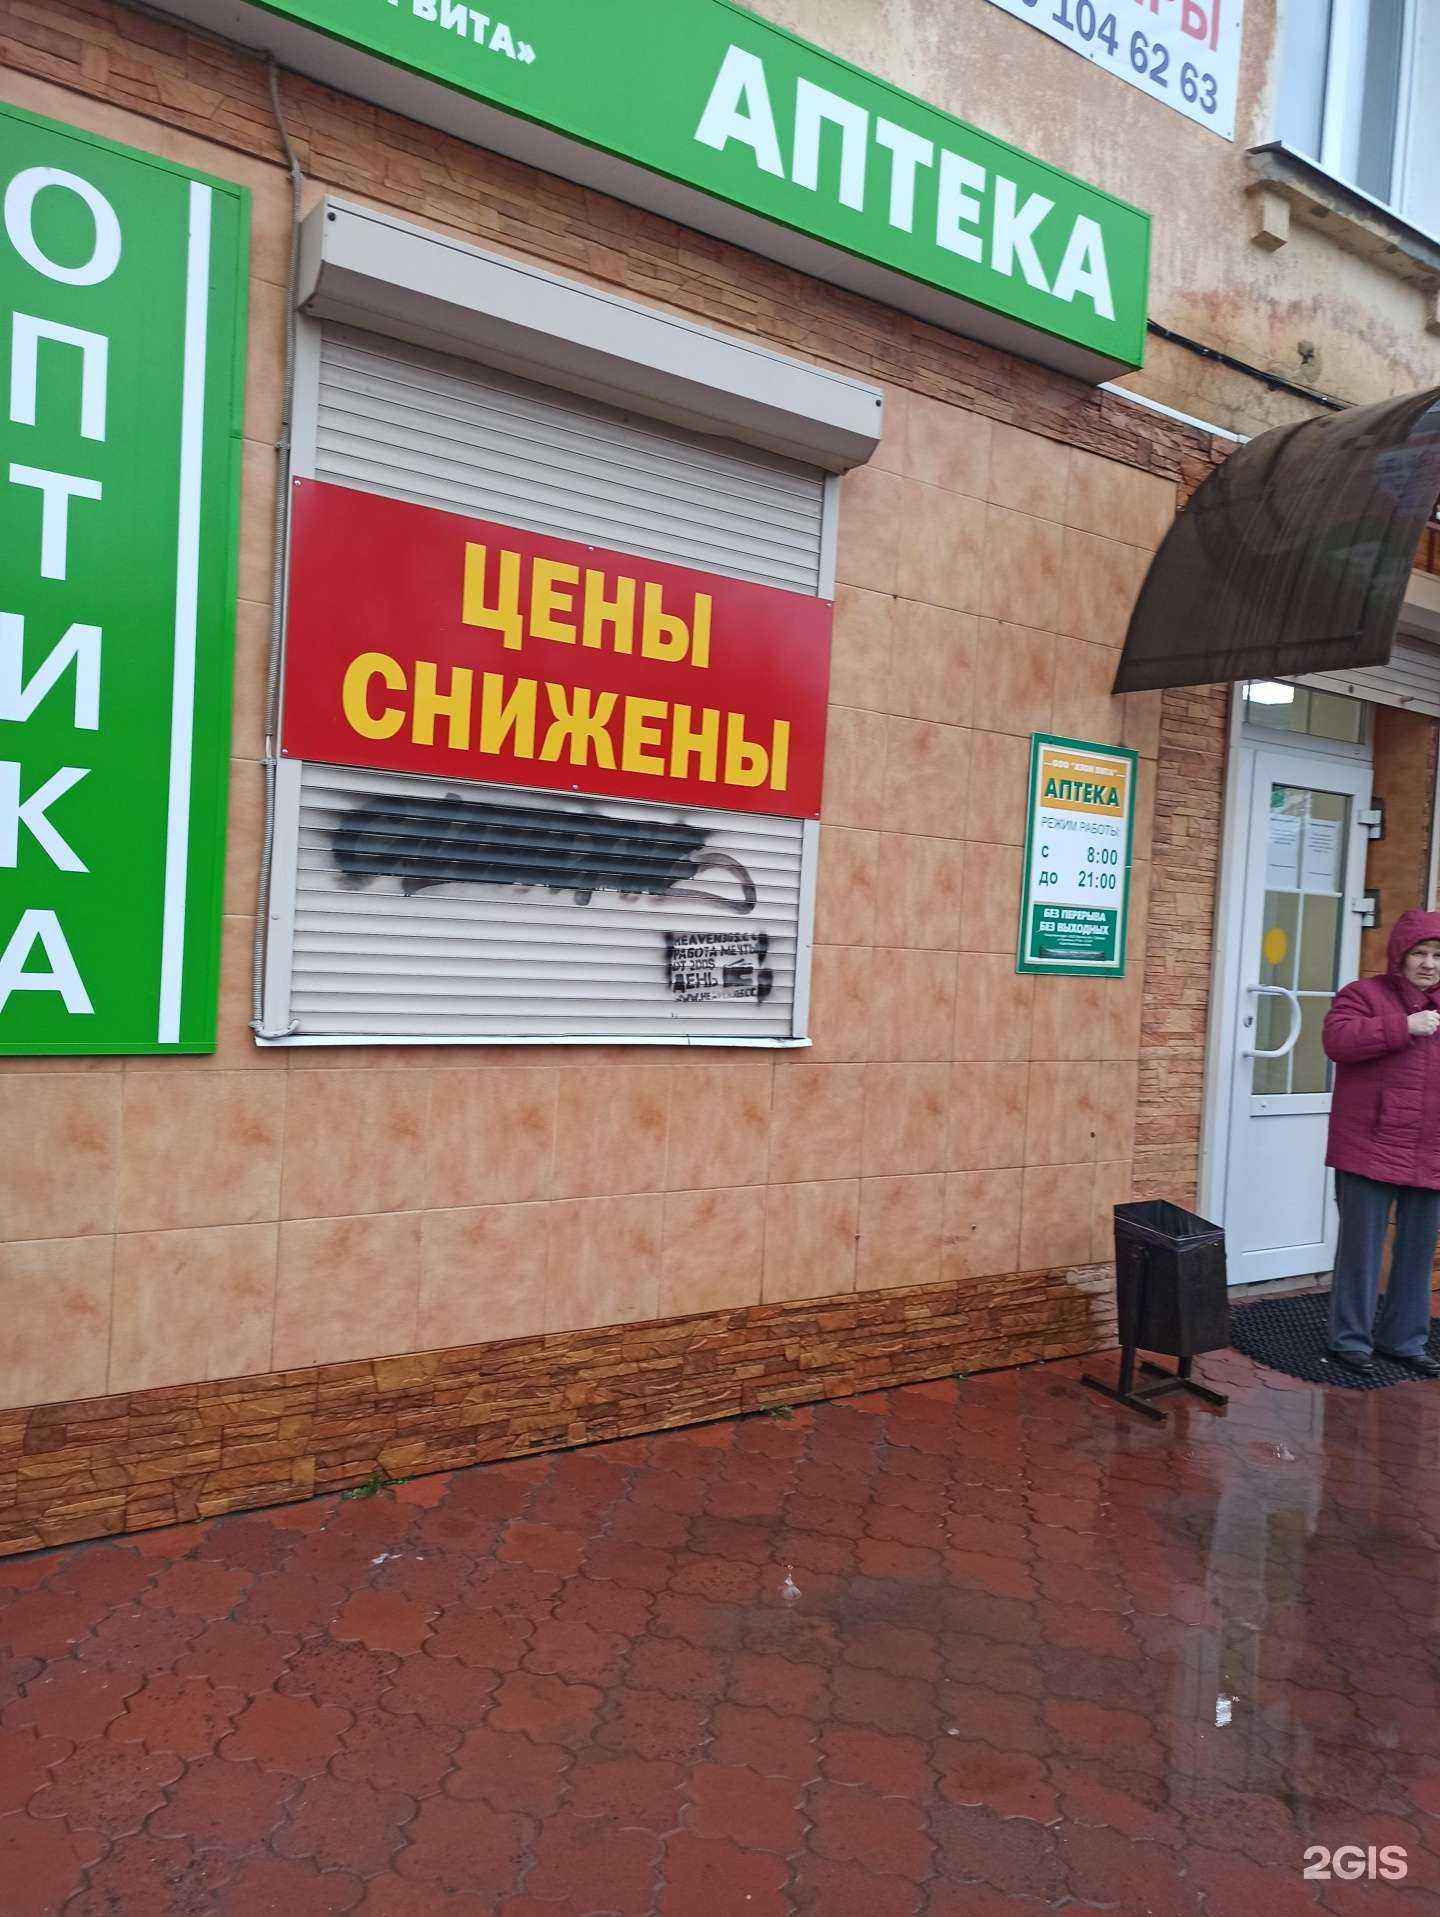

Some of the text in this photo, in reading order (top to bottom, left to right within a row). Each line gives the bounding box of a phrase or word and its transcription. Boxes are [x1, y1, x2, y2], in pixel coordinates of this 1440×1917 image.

[1130, 30, 1170, 89] 62
[1180, 61, 1218, 115] 63
[694, 44, 1116, 322] АПТЕКА
[0, 166, 122, 1015] ОПТИКА
[461, 540, 713, 669] ЦЕНЫ
[342, 652, 790, 792] СНИЖЕНЫ
[1043, 777, 1120, 808] АПТЕКА
[1040, 816, 1077, 831] РЕЖИМ
[1087, 846, 1118, 866] 8:00
[1078, 870, 1116, 890] 21:00
[1039, 921, 1110, 936] БЕЗ ВЫХОДНЫХ
[1043, 908, 1107, 922] БЕЗ ПЕРЕРЫВА
